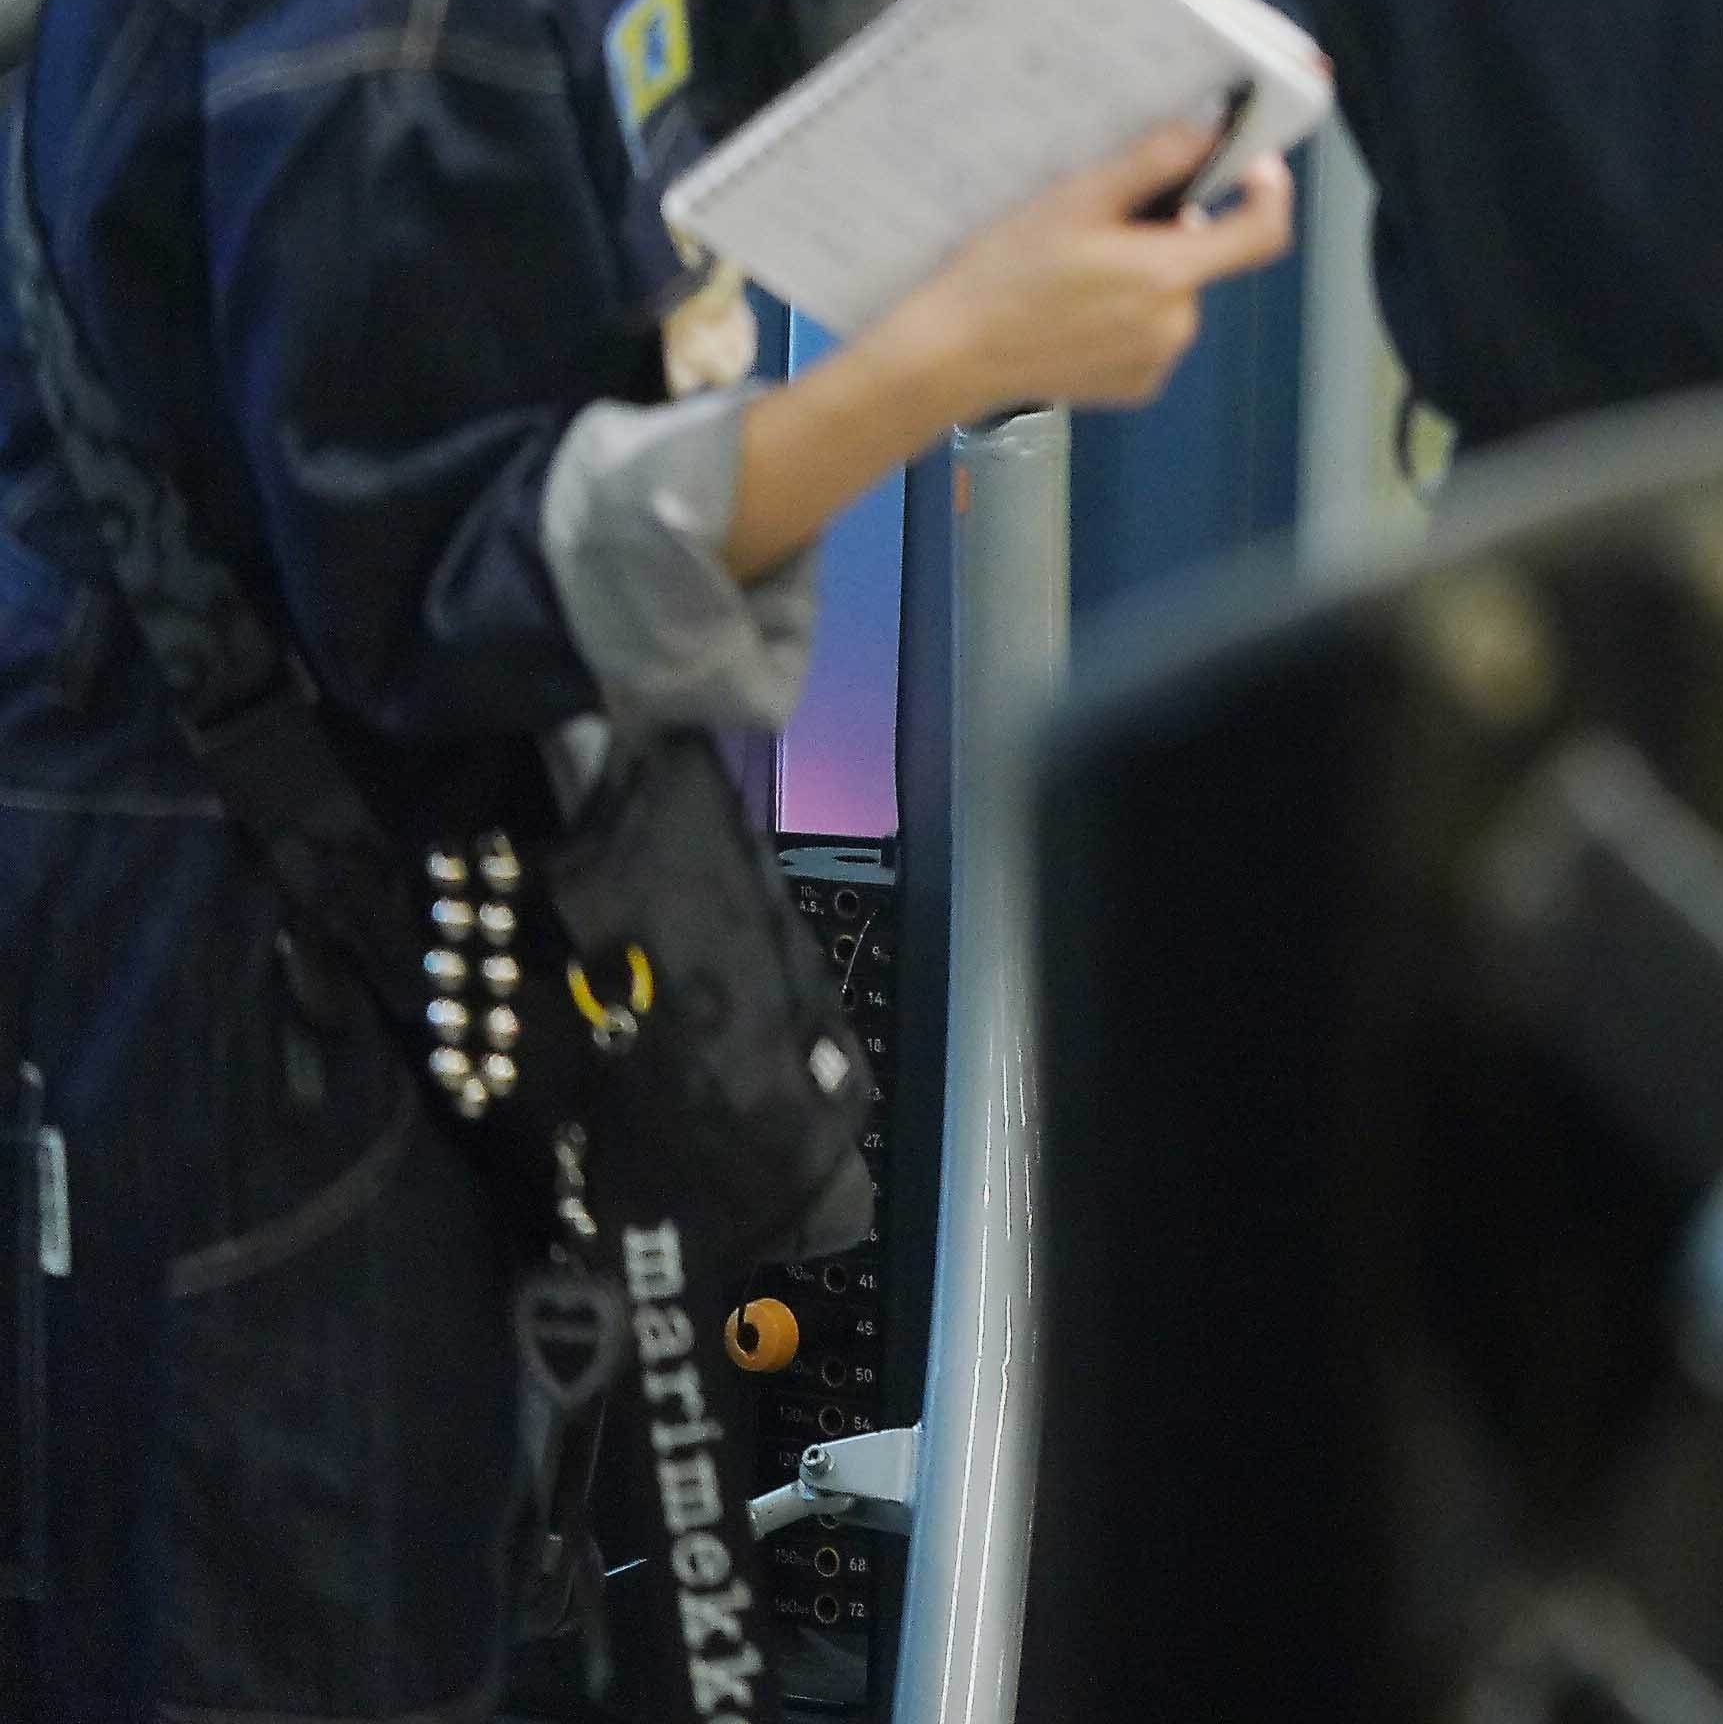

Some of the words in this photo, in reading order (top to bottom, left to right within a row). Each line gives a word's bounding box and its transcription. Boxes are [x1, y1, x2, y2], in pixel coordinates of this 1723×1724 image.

[859, 1275, 874, 1289] 41
[855, 1367, 873, 1383] 50
[622, 1218, 768, 1724] marimekk
[849, 1557, 866, 1572] 68
[849, 1602, 865, 1617] 72
